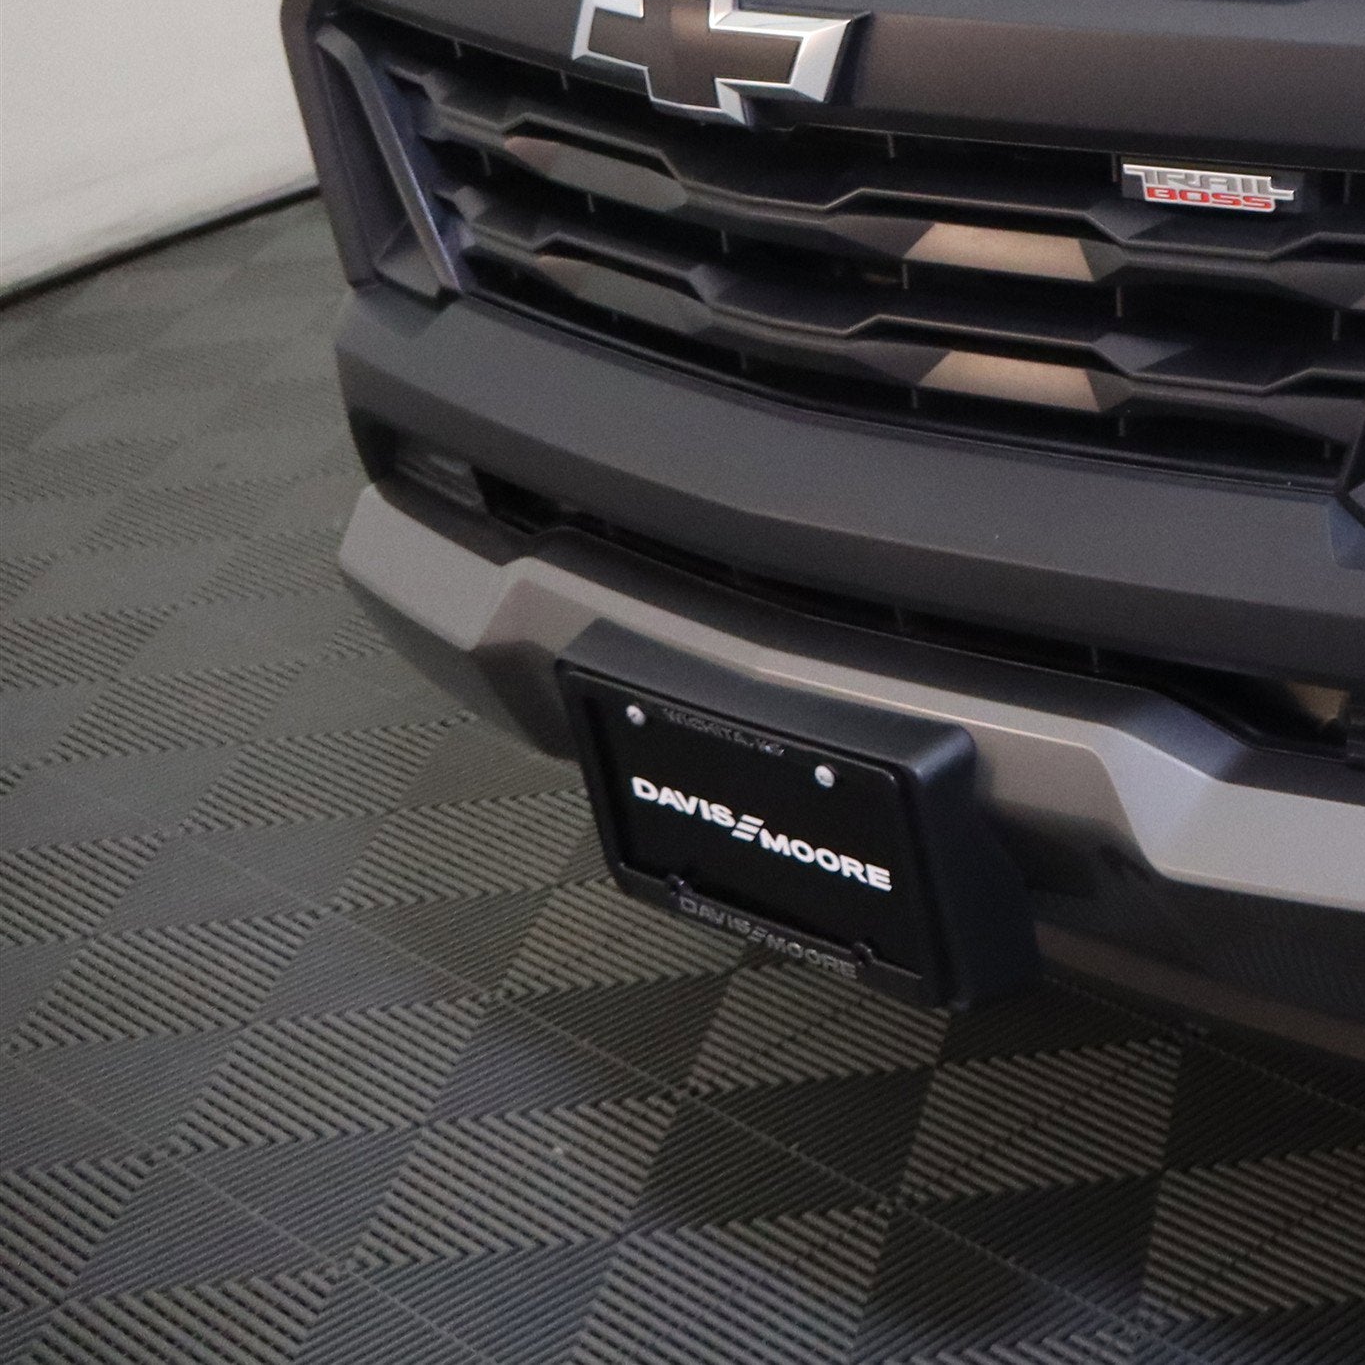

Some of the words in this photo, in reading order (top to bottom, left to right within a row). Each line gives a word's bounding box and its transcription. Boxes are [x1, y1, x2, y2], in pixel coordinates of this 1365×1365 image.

[1122, 163, 1296, 201] TRAIL
[1145, 186, 1276, 212] BOSS
[631, 776, 737, 829] DAVIS
[758, 827, 893, 892] MOORE
[678, 895, 751, 934] DAVIS
[765, 933, 858, 981] MOORE
